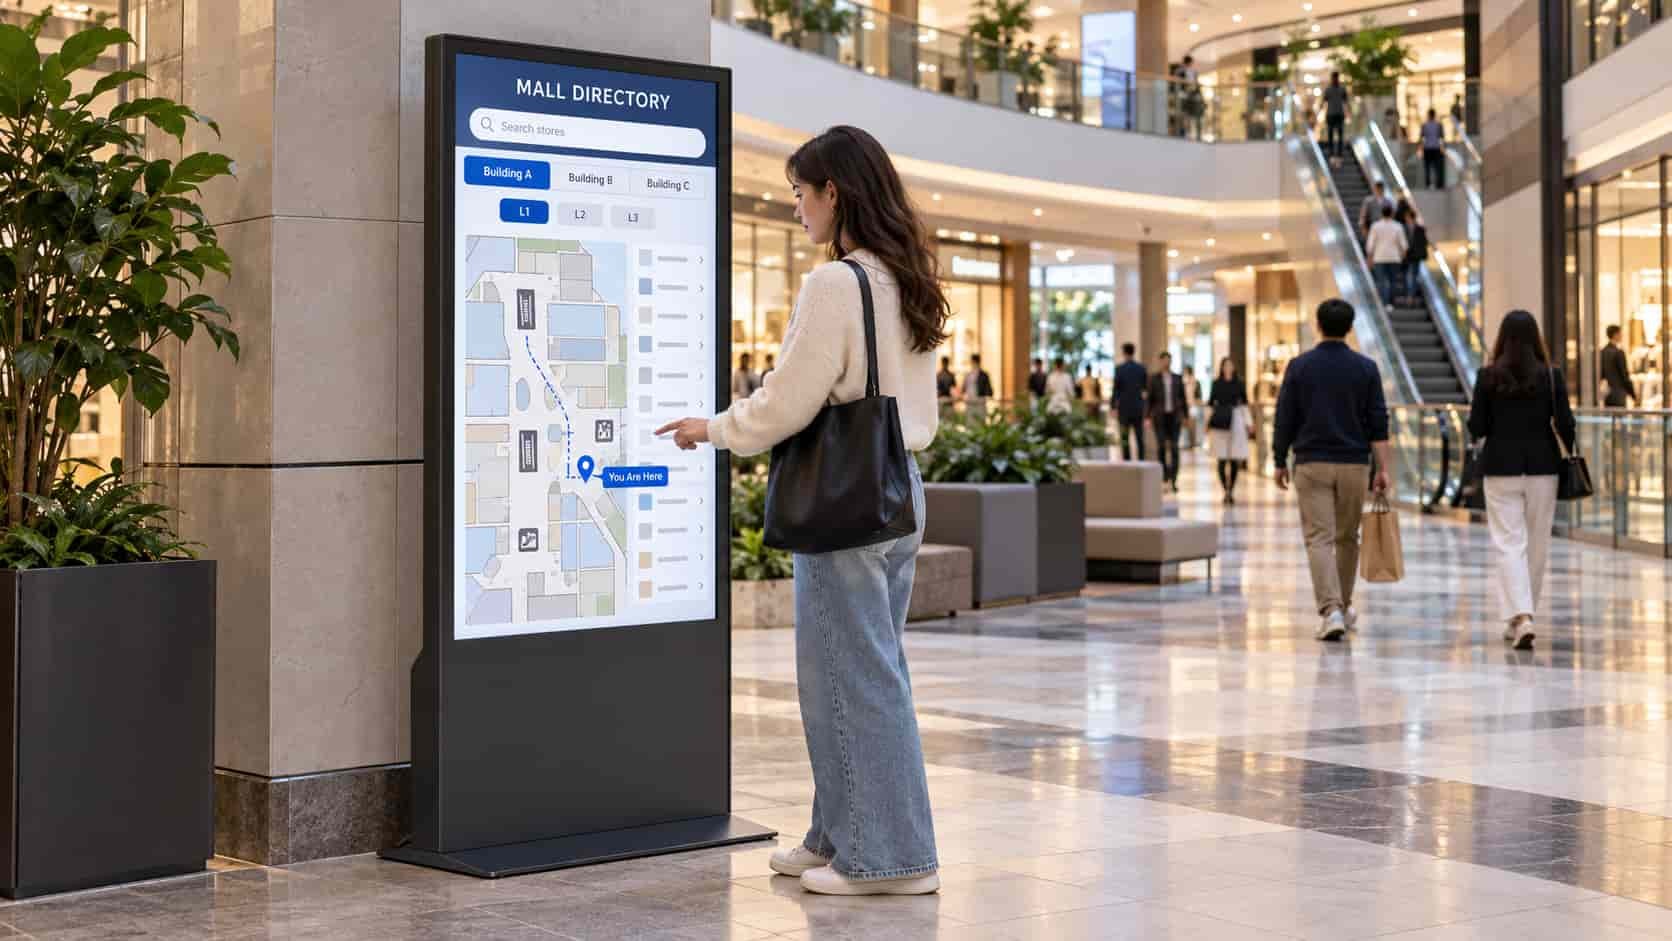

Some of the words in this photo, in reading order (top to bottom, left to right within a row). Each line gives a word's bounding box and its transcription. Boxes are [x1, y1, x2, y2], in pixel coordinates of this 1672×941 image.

[516, 78, 566, 100] MALL
[572, 84, 671, 111] DIRECTORY
[501, 120, 534, 135] Search
[537, 124, 565, 137] stores
[483, 165, 523, 181] Building
[524, 169, 532, 179] A
[568, 172, 605, 186] Building
[607, 175, 613, 185] B
[647, 178, 682, 191] Building
[684, 182, 690, 190] C
[519, 207, 530, 217] L1
[575, 209, 586, 220] L2
[628, 213, 639, 223] L3
[608, 472, 624, 482] You
[626, 472, 641, 481] Are
[643, 471, 663, 481] Here
